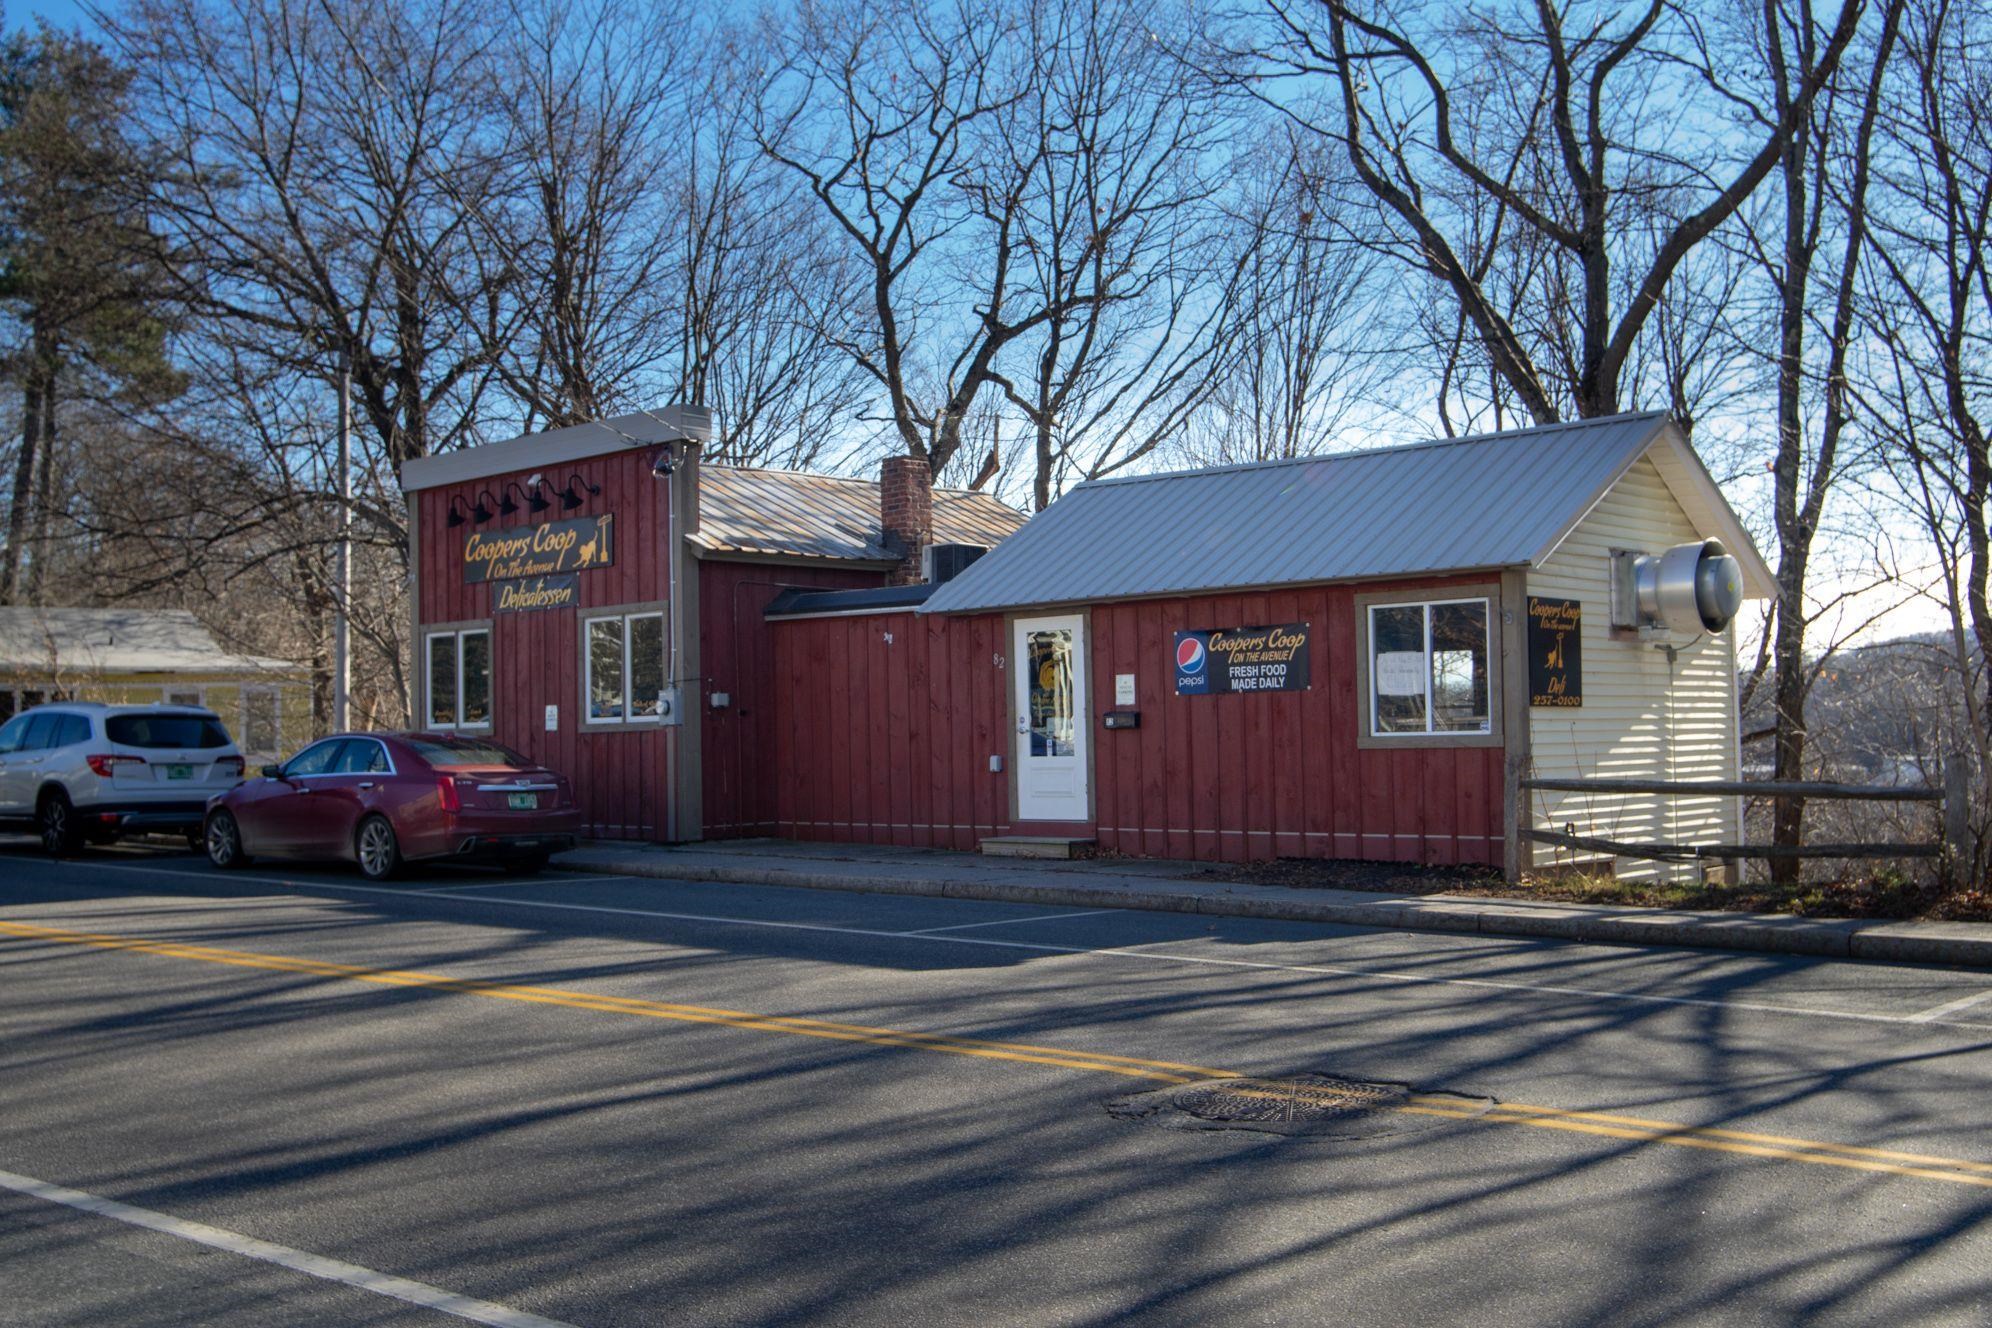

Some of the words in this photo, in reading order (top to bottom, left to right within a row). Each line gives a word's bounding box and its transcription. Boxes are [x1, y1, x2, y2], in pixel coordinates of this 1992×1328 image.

[465, 534, 531, 579] Coopers
[533, 523, 577, 571] Coop
[494, 563, 506, 578] On
[508, 559, 523, 577] The
[523, 560, 554, 576] Avenue
[499, 578, 571, 610] Delicatessen
[1529, 598, 1560, 628] Coopers
[1561, 601, 1582, 630] Coop
[1208, 632, 1267, 664] Coopers
[1268, 628, 1306, 661] Coop
[993, 653, 1005, 668] 82
[1233, 653, 1244, 663] ON
[1245, 652, 1260, 662] THE
[1259, 650, 1290, 662] AVENUE
[1229, 665, 1258, 677] FRESH
[1260, 664, 1287, 676] FOOD
[1178, 675, 1204, 688] pepsi
[1231, 678, 1257, 690] MADE
[1259, 677, 1286, 689] DAILY
